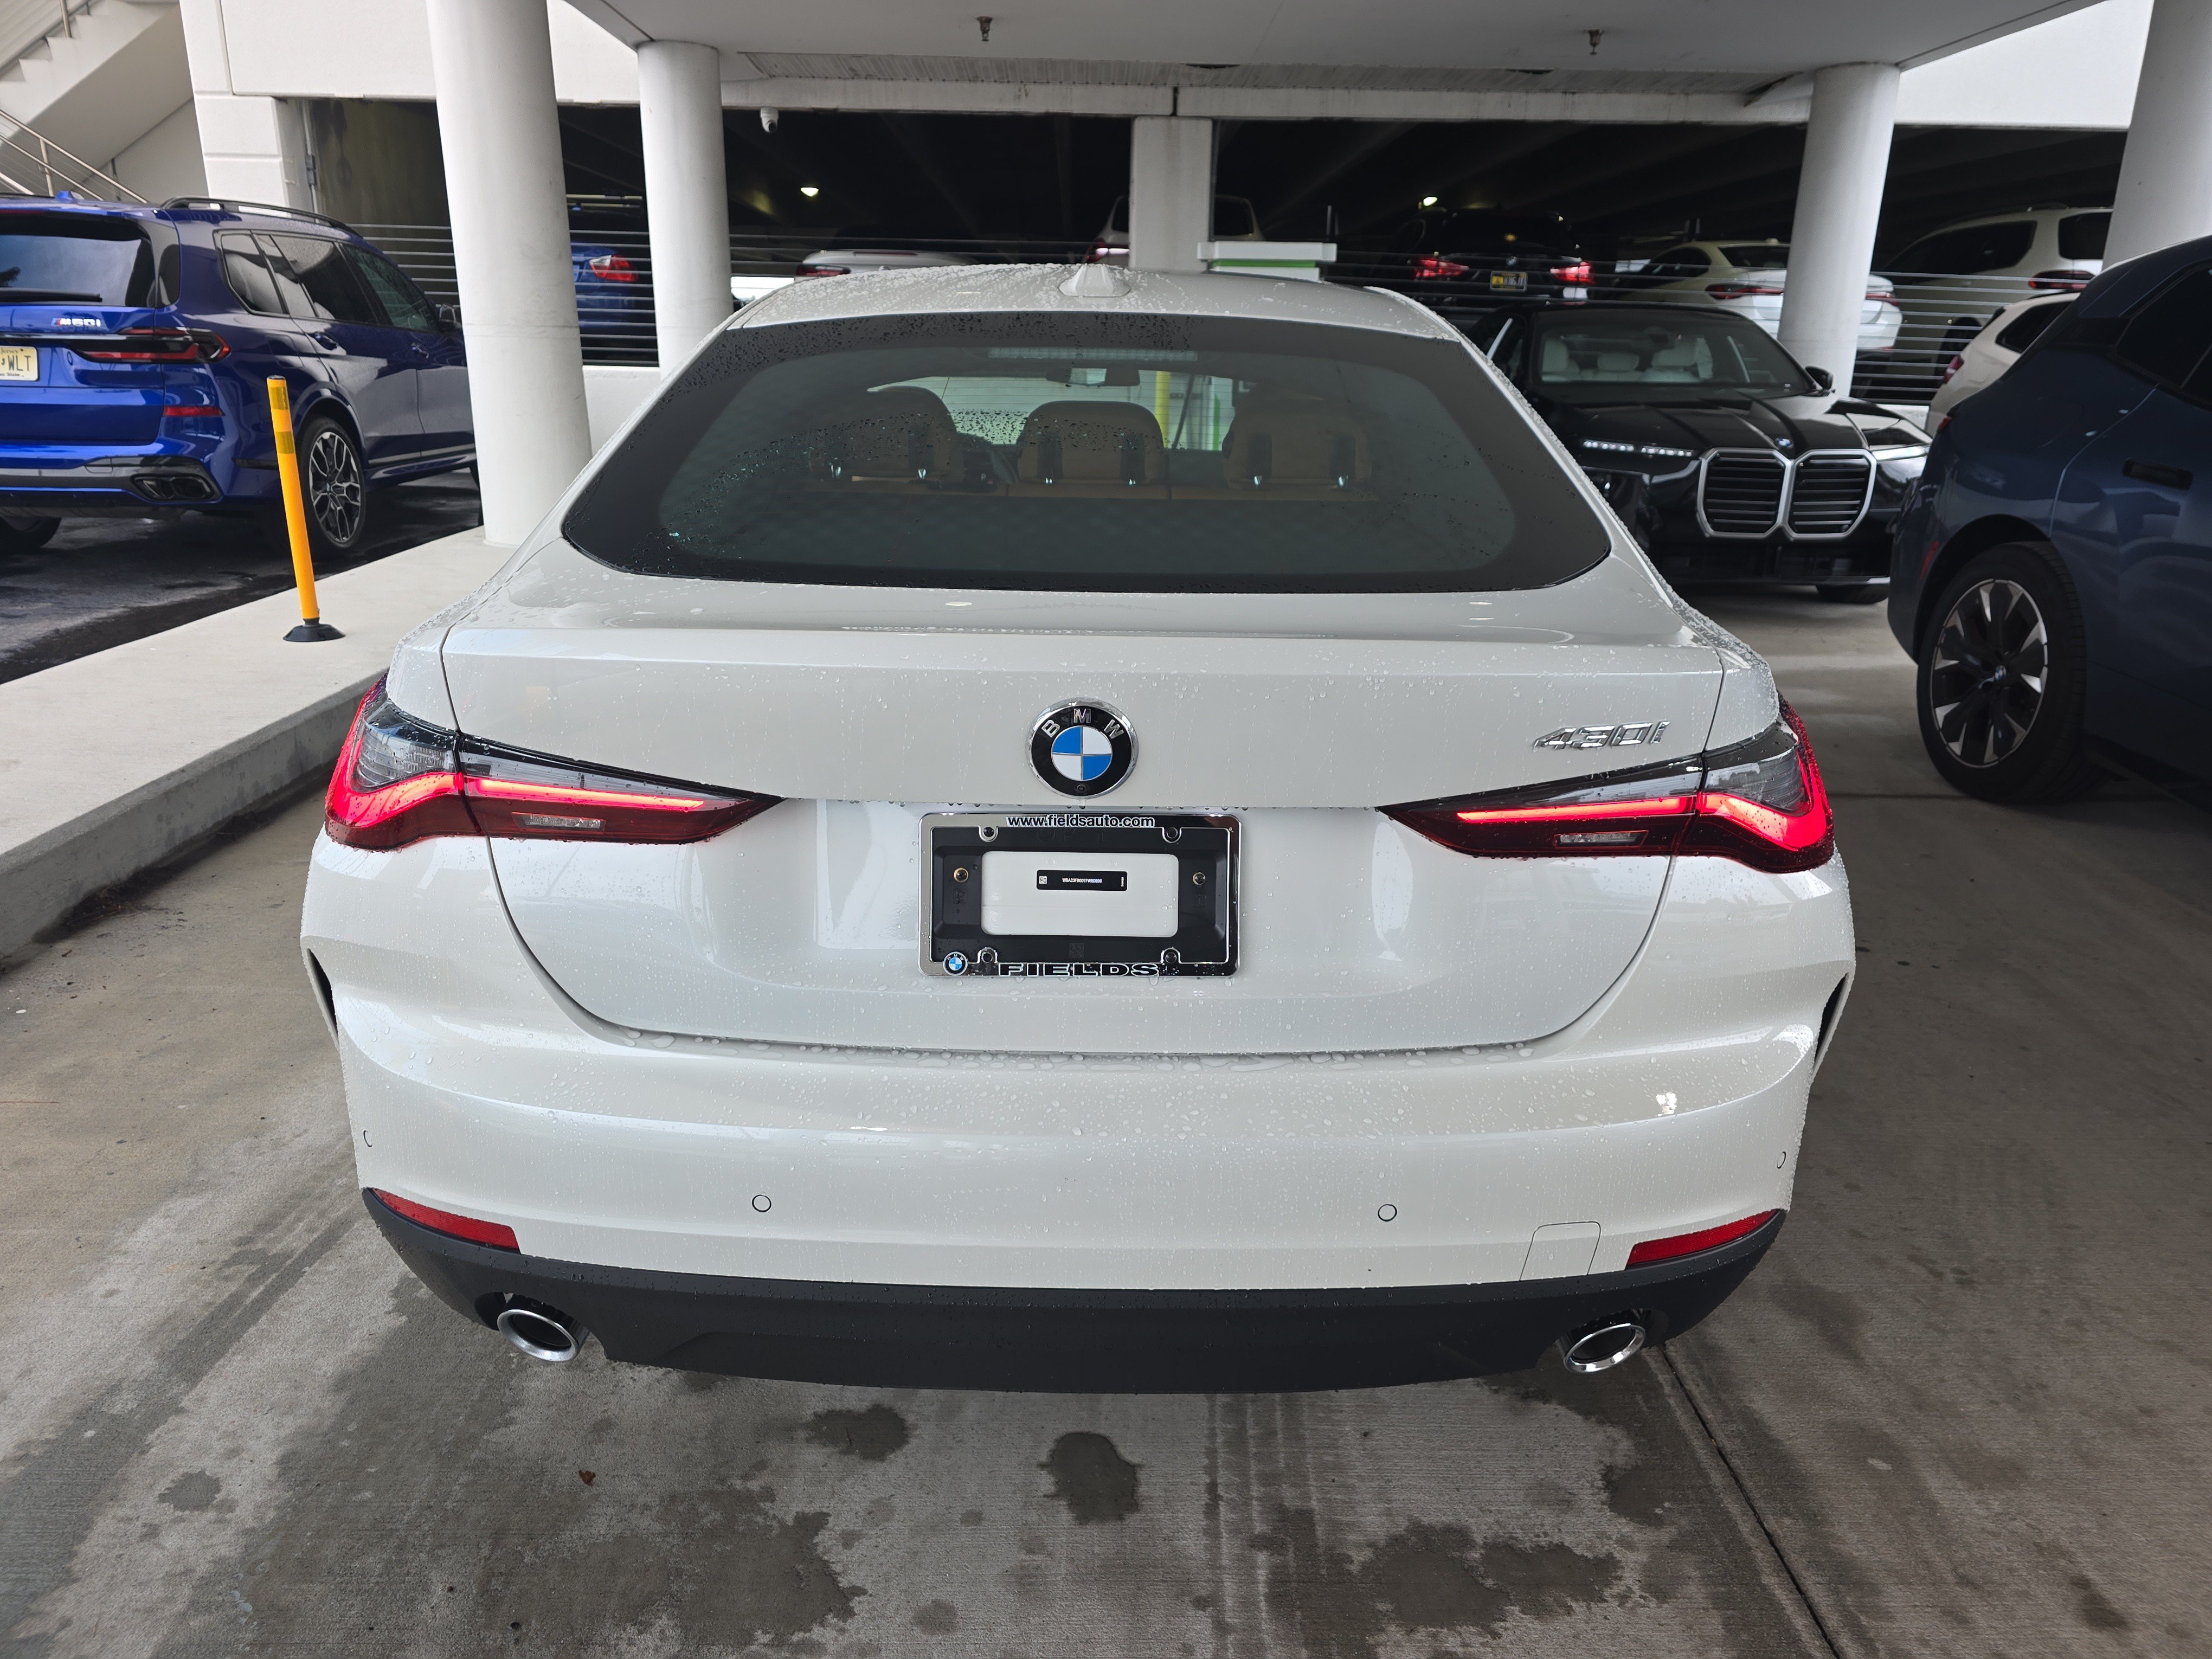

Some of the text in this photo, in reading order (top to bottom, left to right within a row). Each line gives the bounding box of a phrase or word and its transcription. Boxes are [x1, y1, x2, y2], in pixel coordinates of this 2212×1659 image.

[1041, 708, 1124, 740] BMW
[1533, 721, 1671, 749] 430i
[1006, 814, 1155, 827] www.fieldsauto.com
[999, 963, 1160, 977] FIELDS
